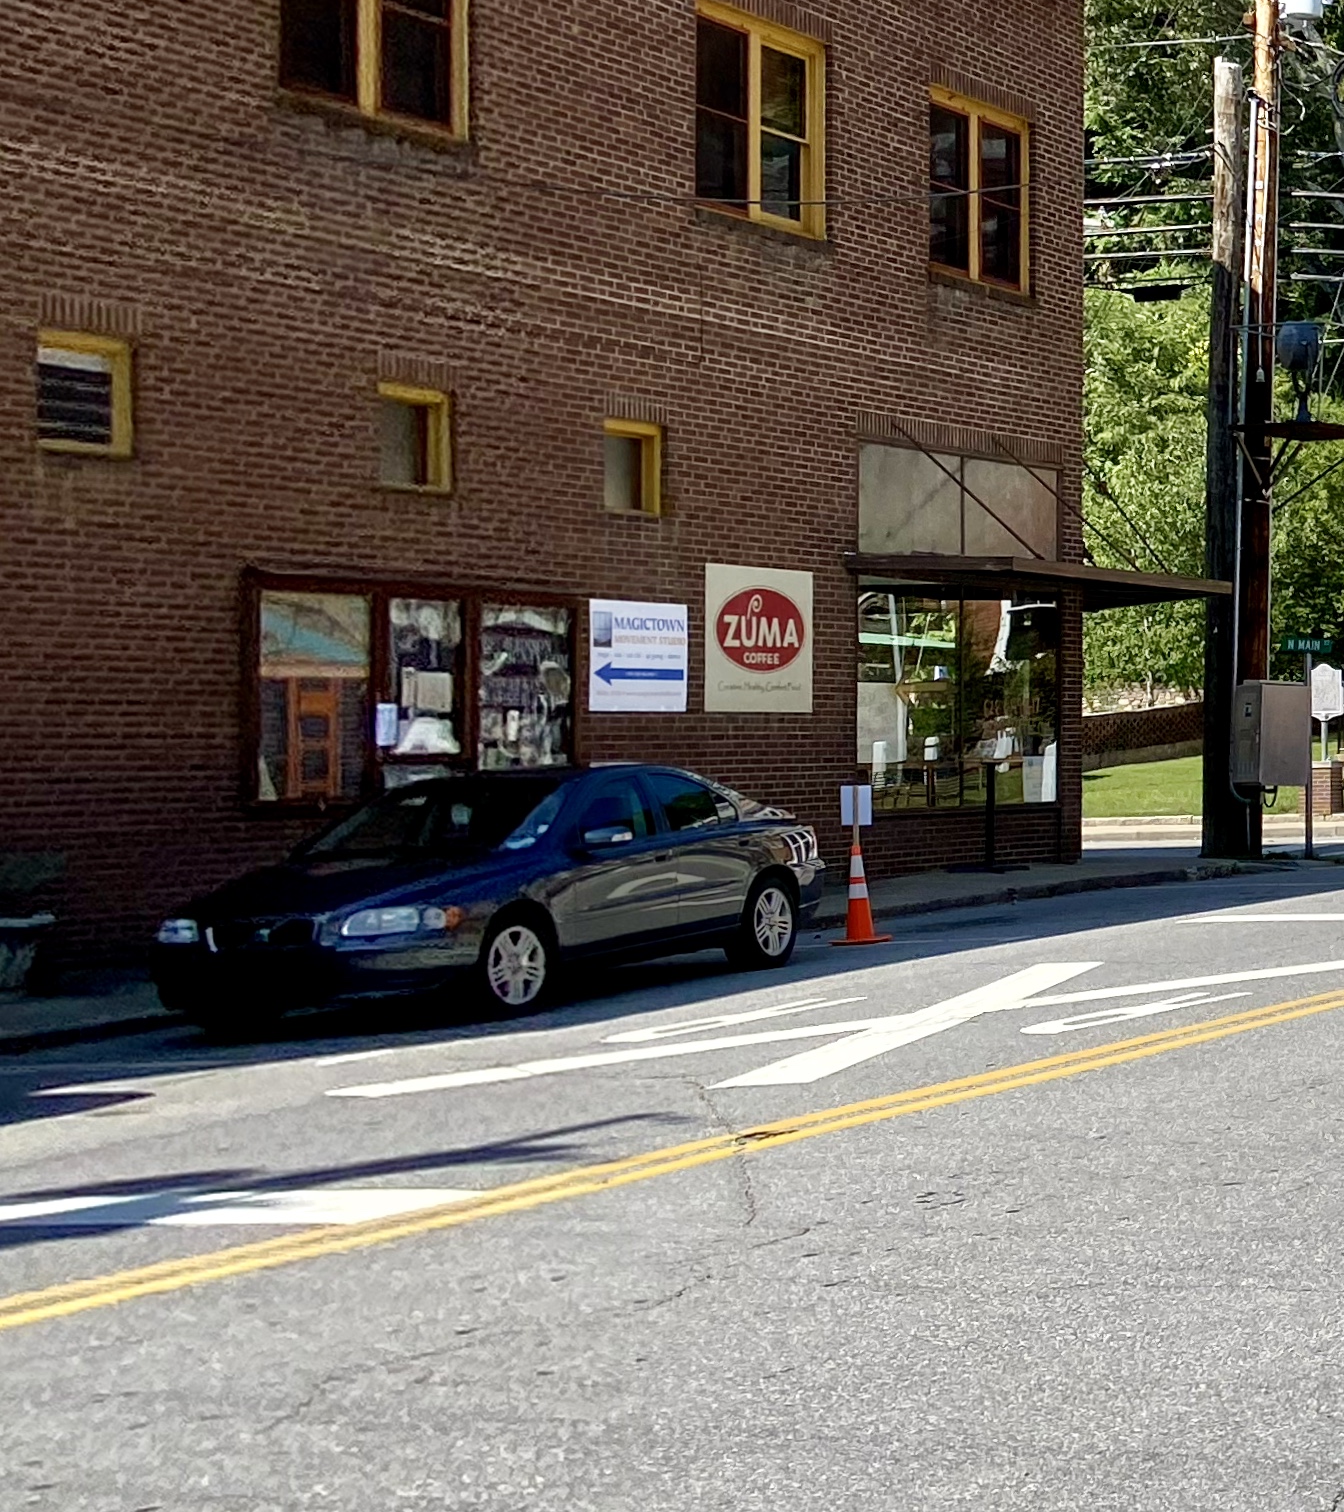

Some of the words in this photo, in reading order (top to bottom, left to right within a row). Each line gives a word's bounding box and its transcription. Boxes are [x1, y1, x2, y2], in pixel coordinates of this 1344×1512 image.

[614, 617, 685, 632] MAGICTOWN
[722, 614, 800, 648] ZUMA
[1287, 639, 1296, 650] N
[1298, 639, 1321, 651] MAIN
[743, 652, 780, 665] COFFEE
